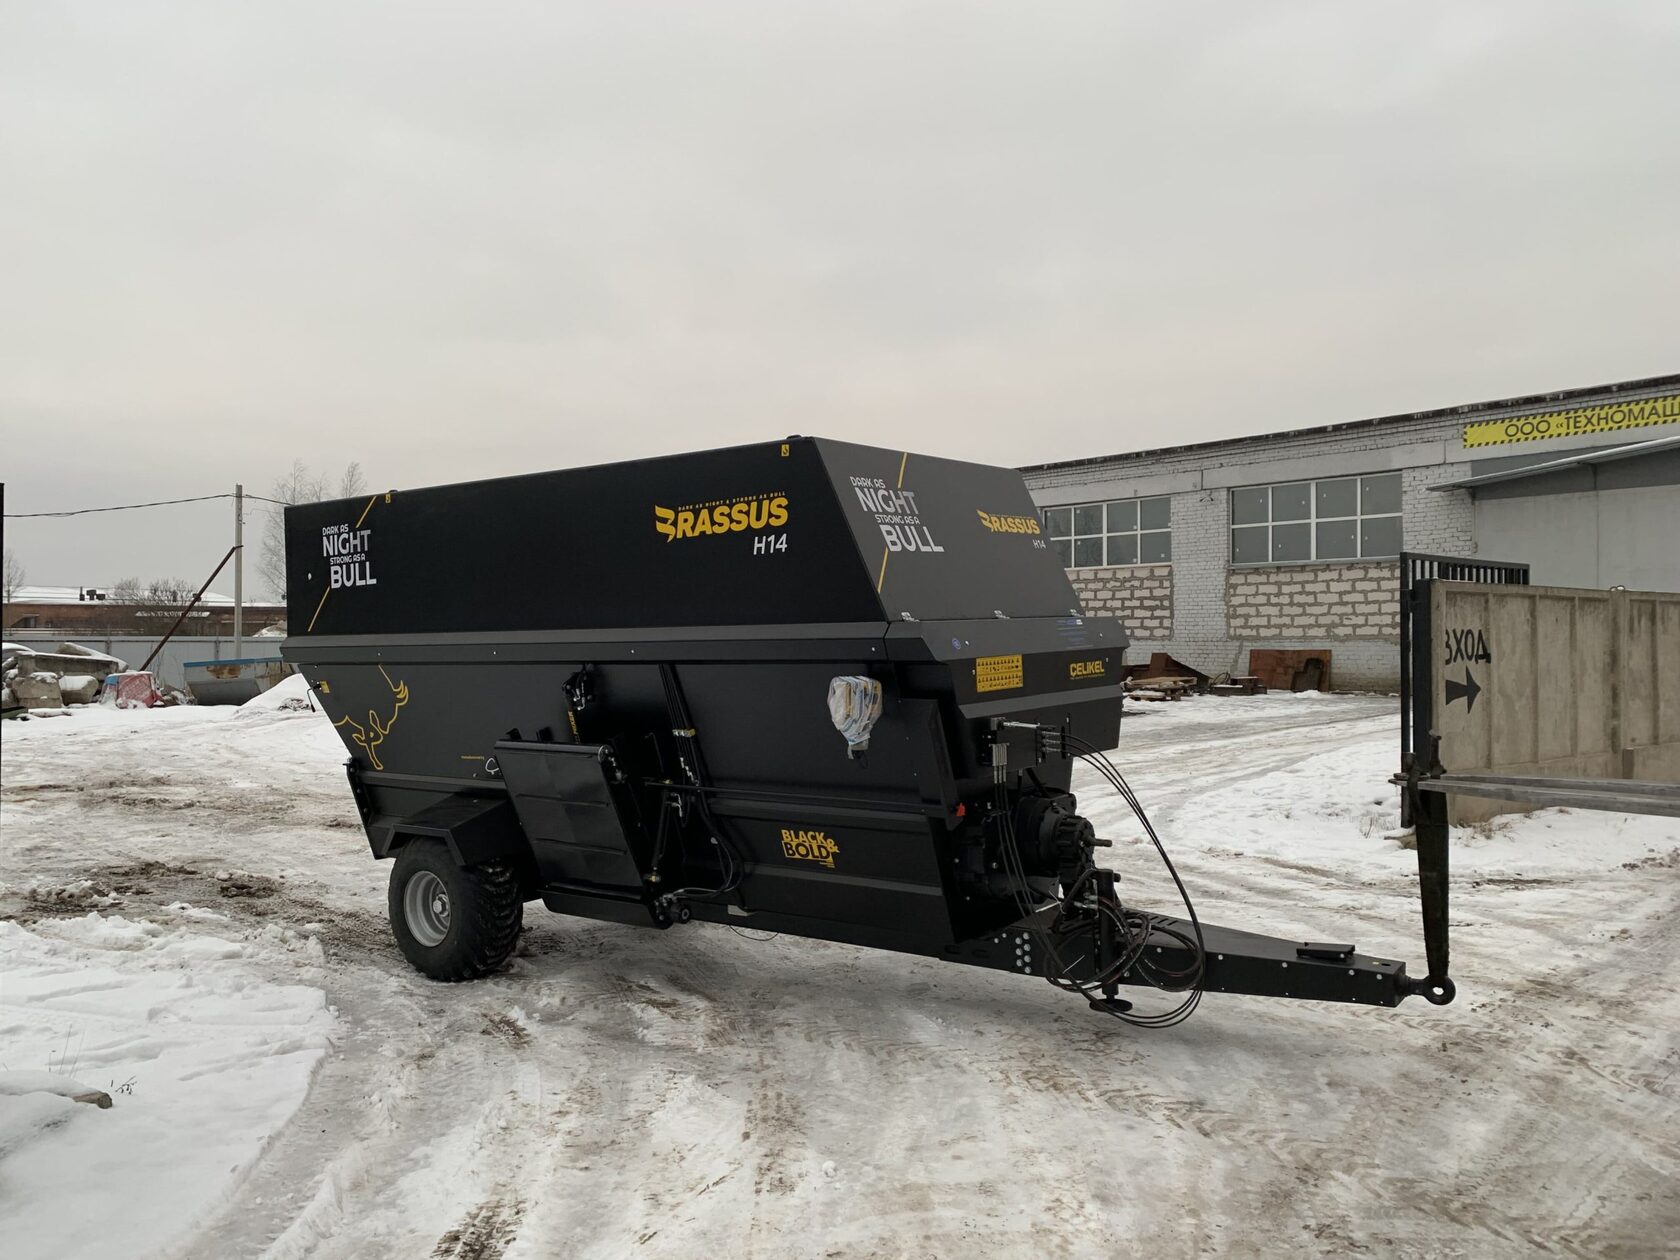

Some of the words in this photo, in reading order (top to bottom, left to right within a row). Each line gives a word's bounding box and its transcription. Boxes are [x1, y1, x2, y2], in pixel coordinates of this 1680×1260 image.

[1504, 419, 1551, 438] ООО
[850, 476, 874, 488] DARK
[874, 479, 886, 489] AS
[854, 487, 919, 515] NIGHT
[322, 525, 339, 535] DARK
[340, 524, 349, 533] AS
[875, 514, 904, 524] STRONG
[904, 515, 914, 524] AS
[914, 516, 921, 525] A
[323, 530, 371, 557] NIGHT
[753, 533, 788, 555] H14
[879, 524, 945, 552] BULL
[330, 555, 352, 565] STRONG
[353, 554, 361, 562] AS
[361, 553, 366, 561] A
[330, 561, 377, 589] BULL
[781, 829, 827, 845] BLACK
[826, 838, 840, 853] &
[783, 842, 831, 859] BOLD
